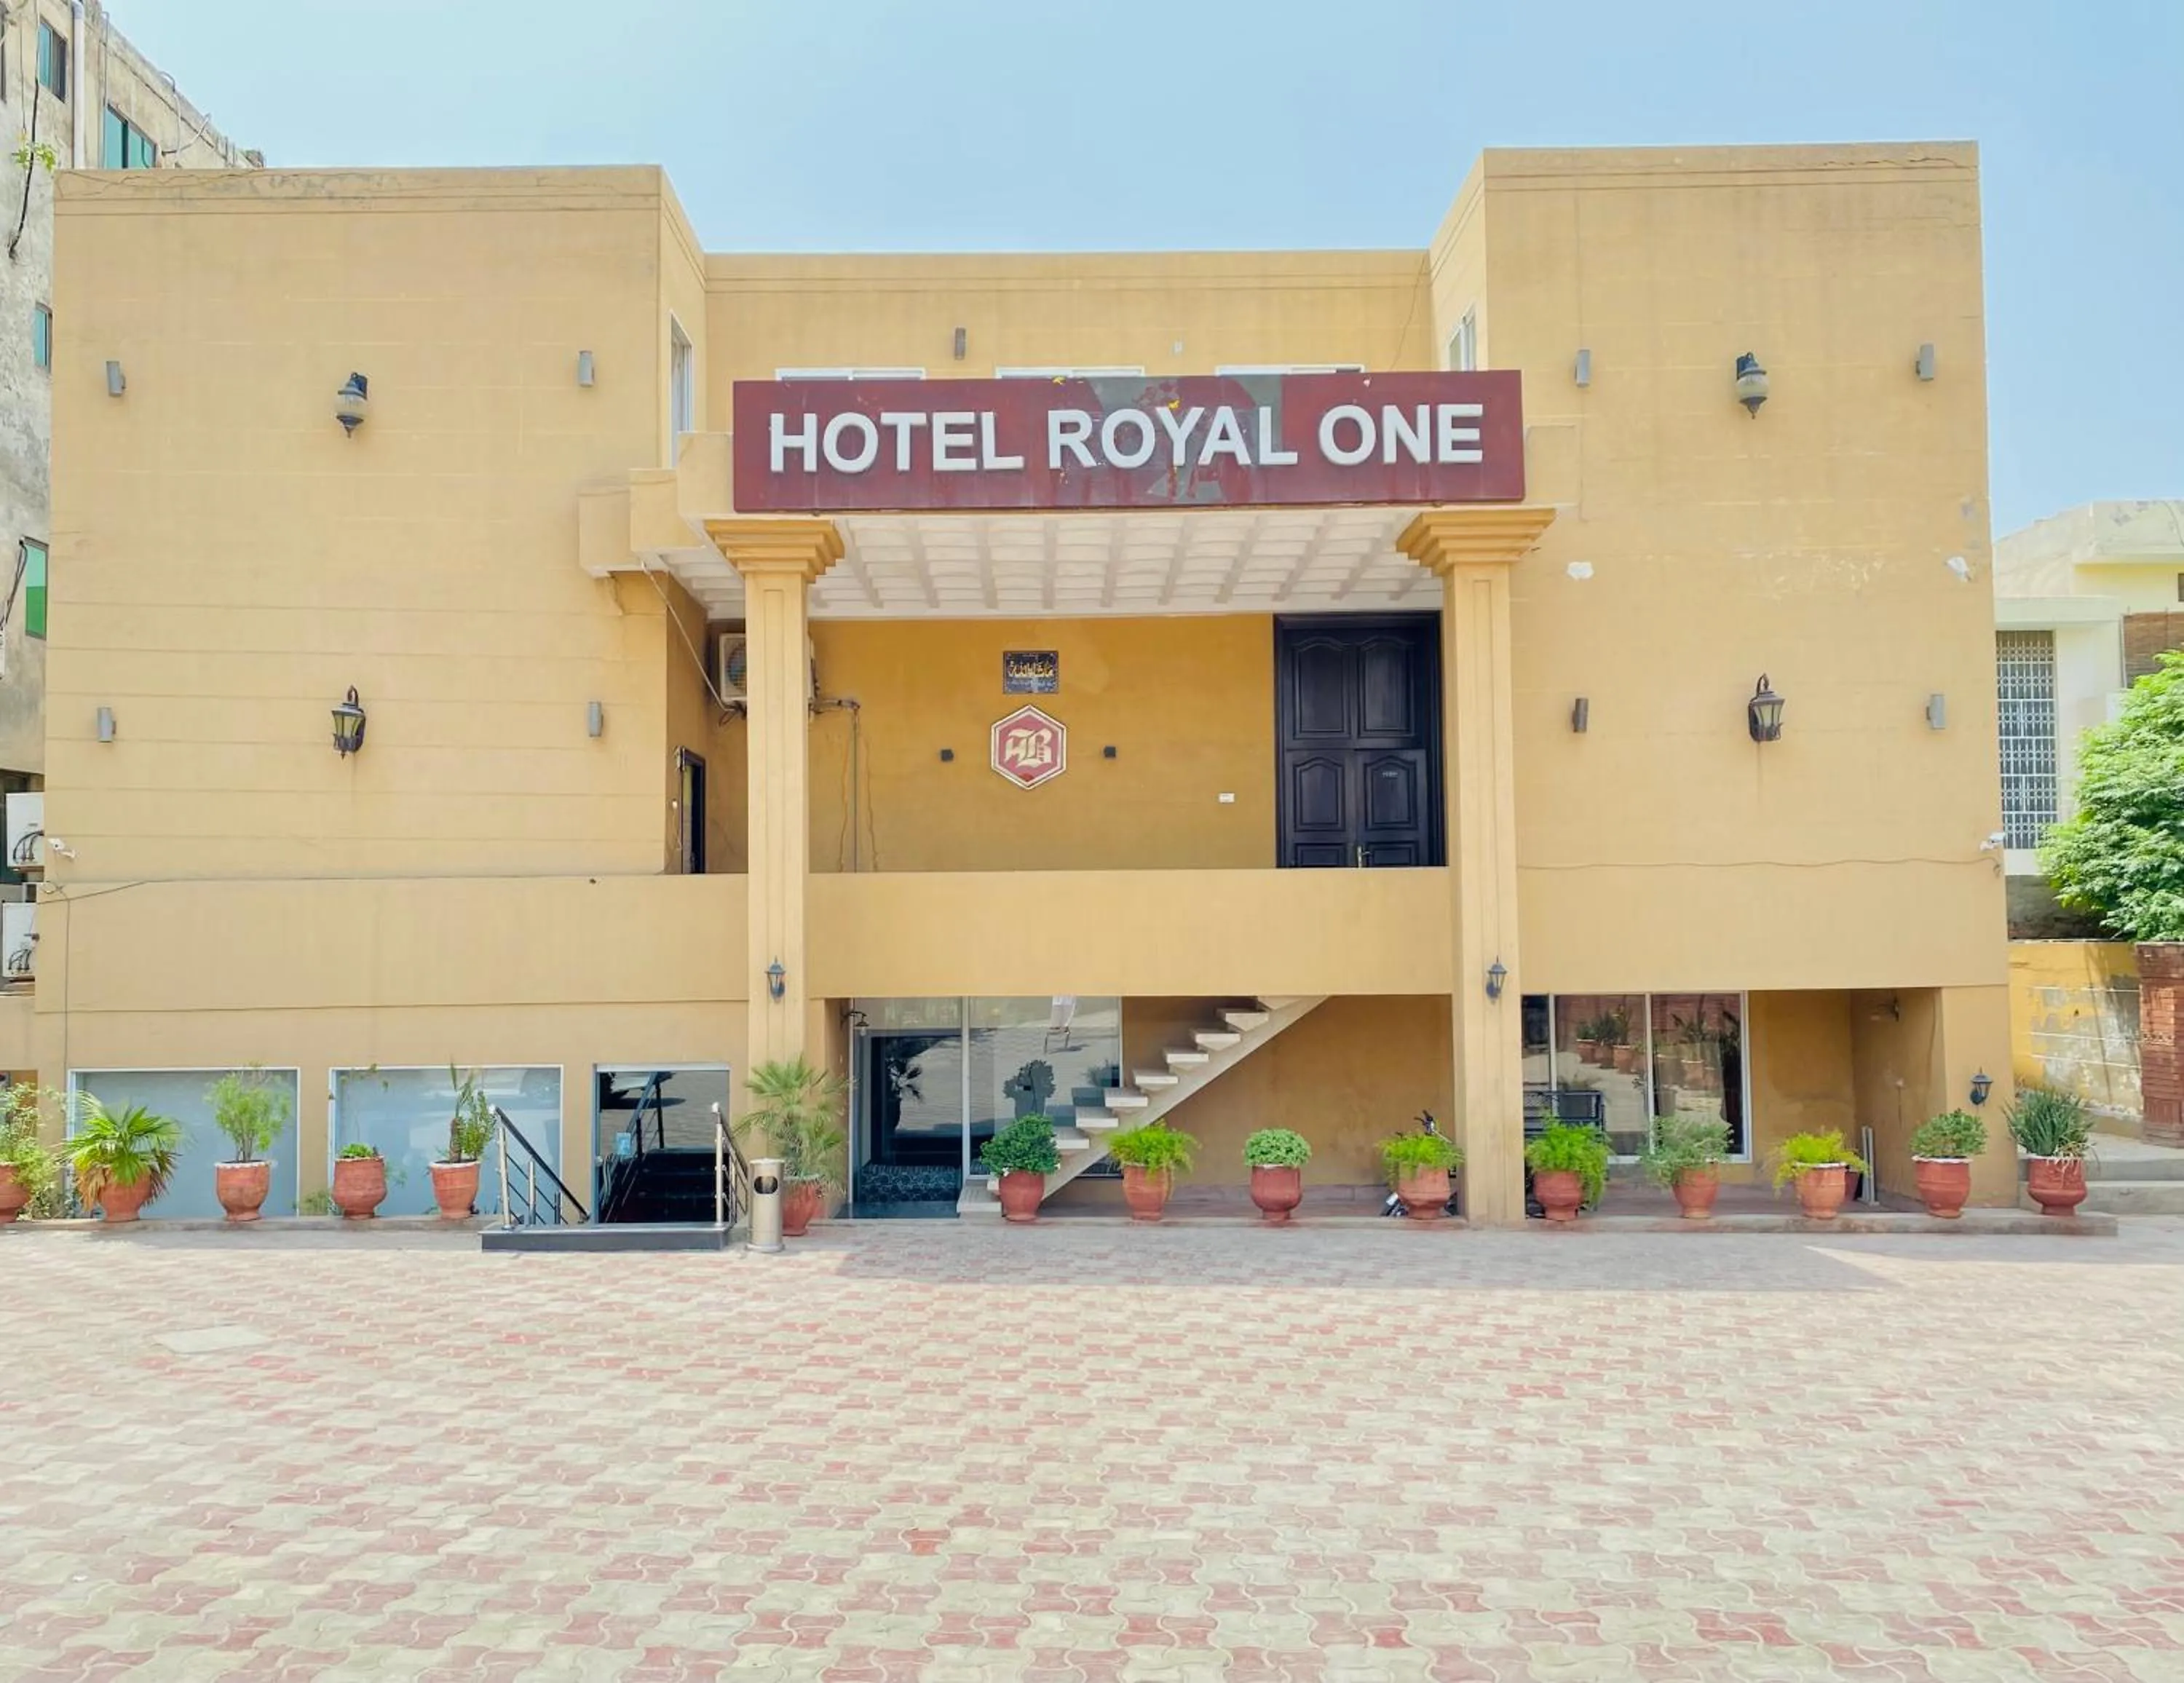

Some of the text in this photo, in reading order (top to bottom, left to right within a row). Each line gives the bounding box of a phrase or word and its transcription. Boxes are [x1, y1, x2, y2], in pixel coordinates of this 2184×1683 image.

[769, 403, 1484, 472] HOTEL ROYAL ONE
